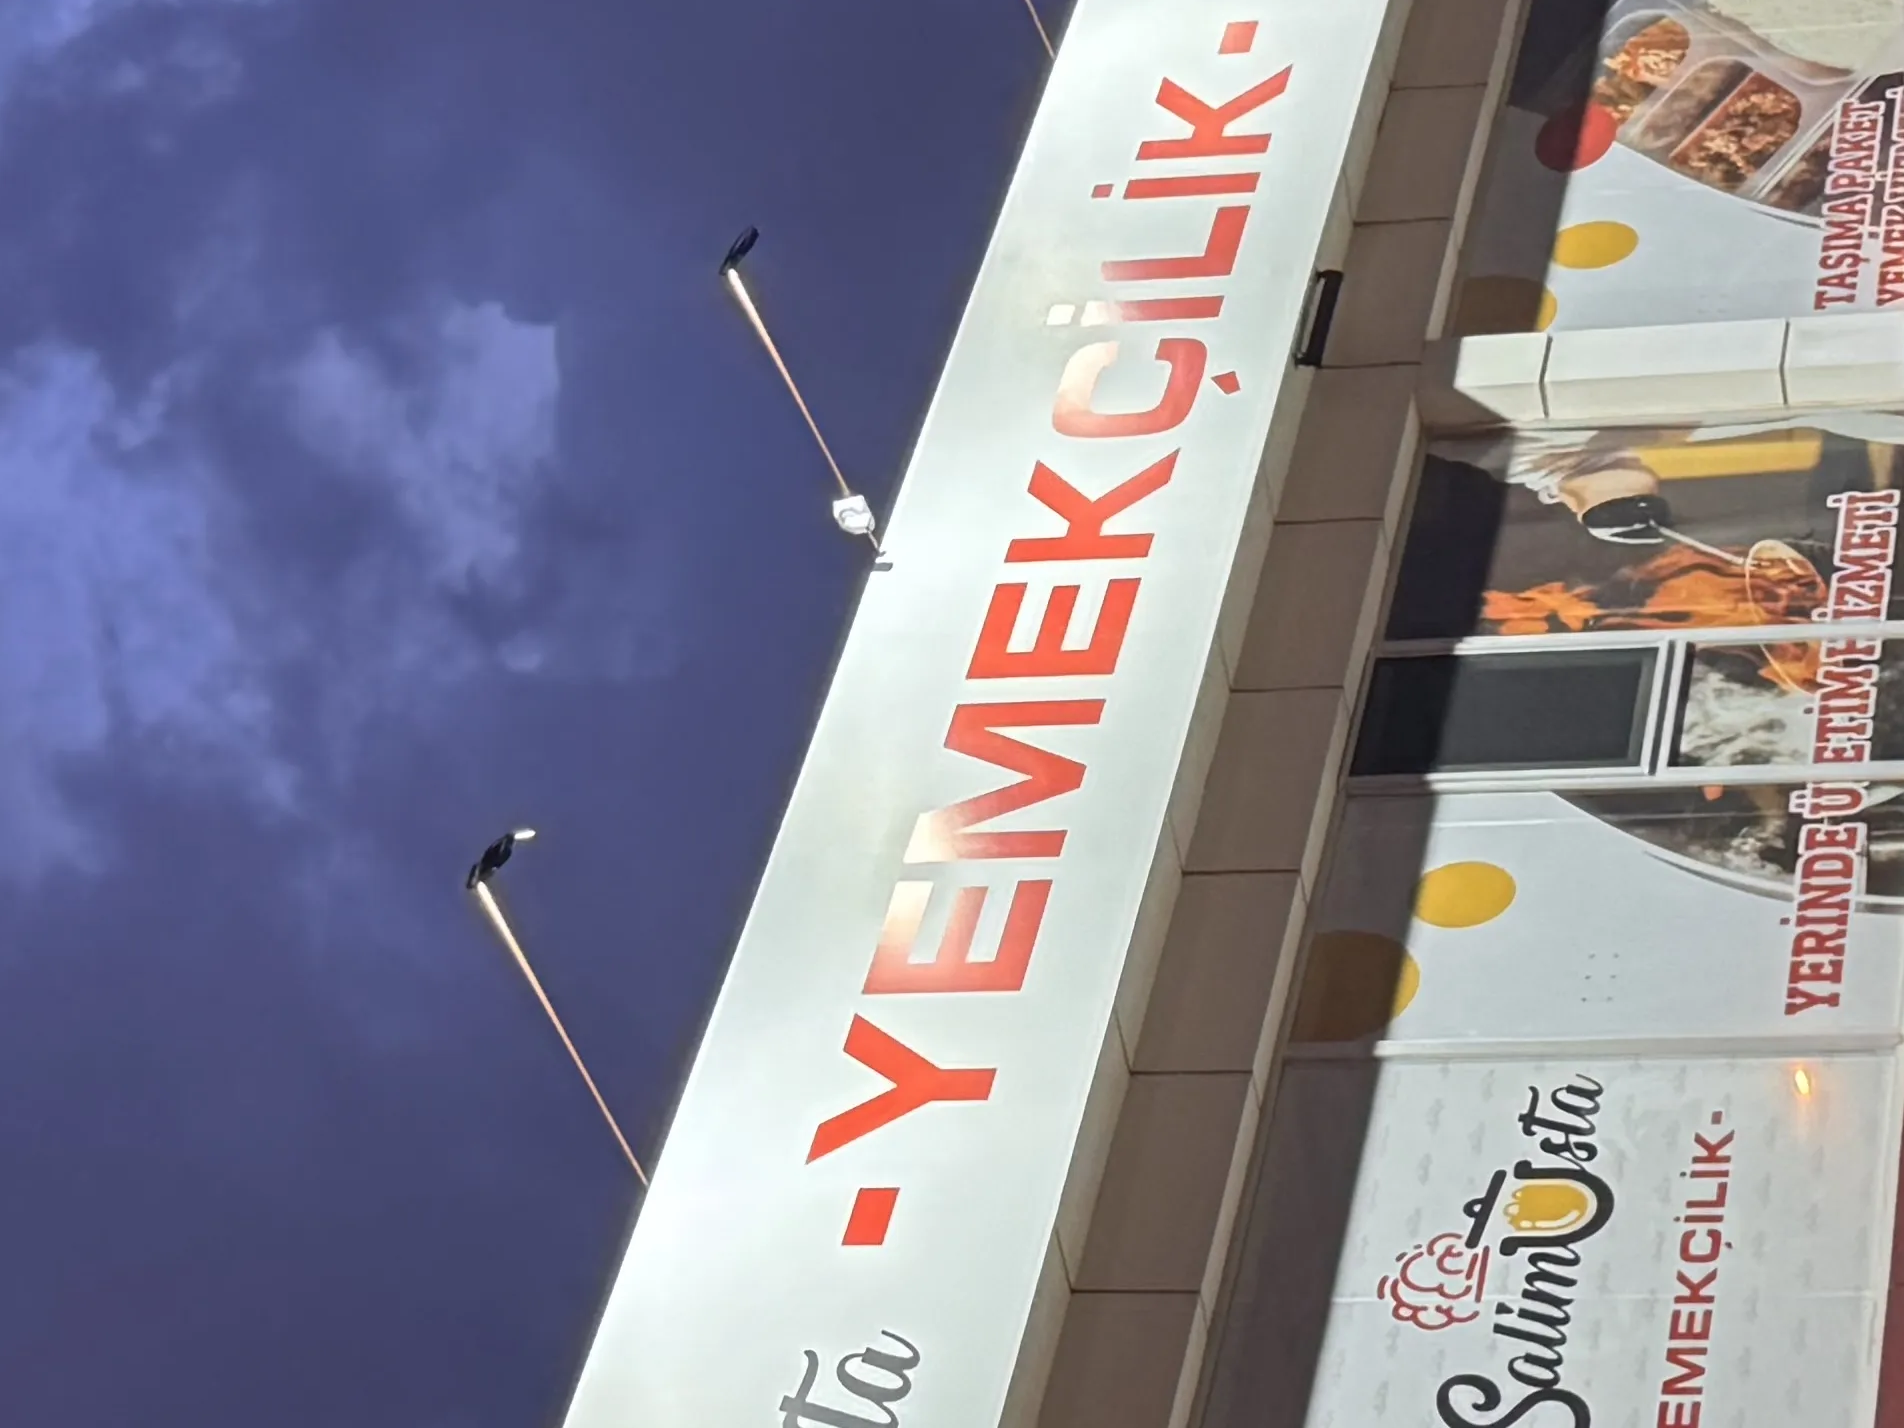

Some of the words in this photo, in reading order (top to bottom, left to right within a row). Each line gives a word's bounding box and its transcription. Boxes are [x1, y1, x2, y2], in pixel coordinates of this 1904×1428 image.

[1828, 101, 1881, 191] PAKET
[1814, 196, 1869, 310] TAŞIMA
[803, 19, 1293, 1247] -YEMEKÇİLİK-
[1790, 663, 1879, 817] ÜETİM
[1780, 826, 1859, 1015] YERİNDE
[1499, 1074, 1614, 1255] Usta
